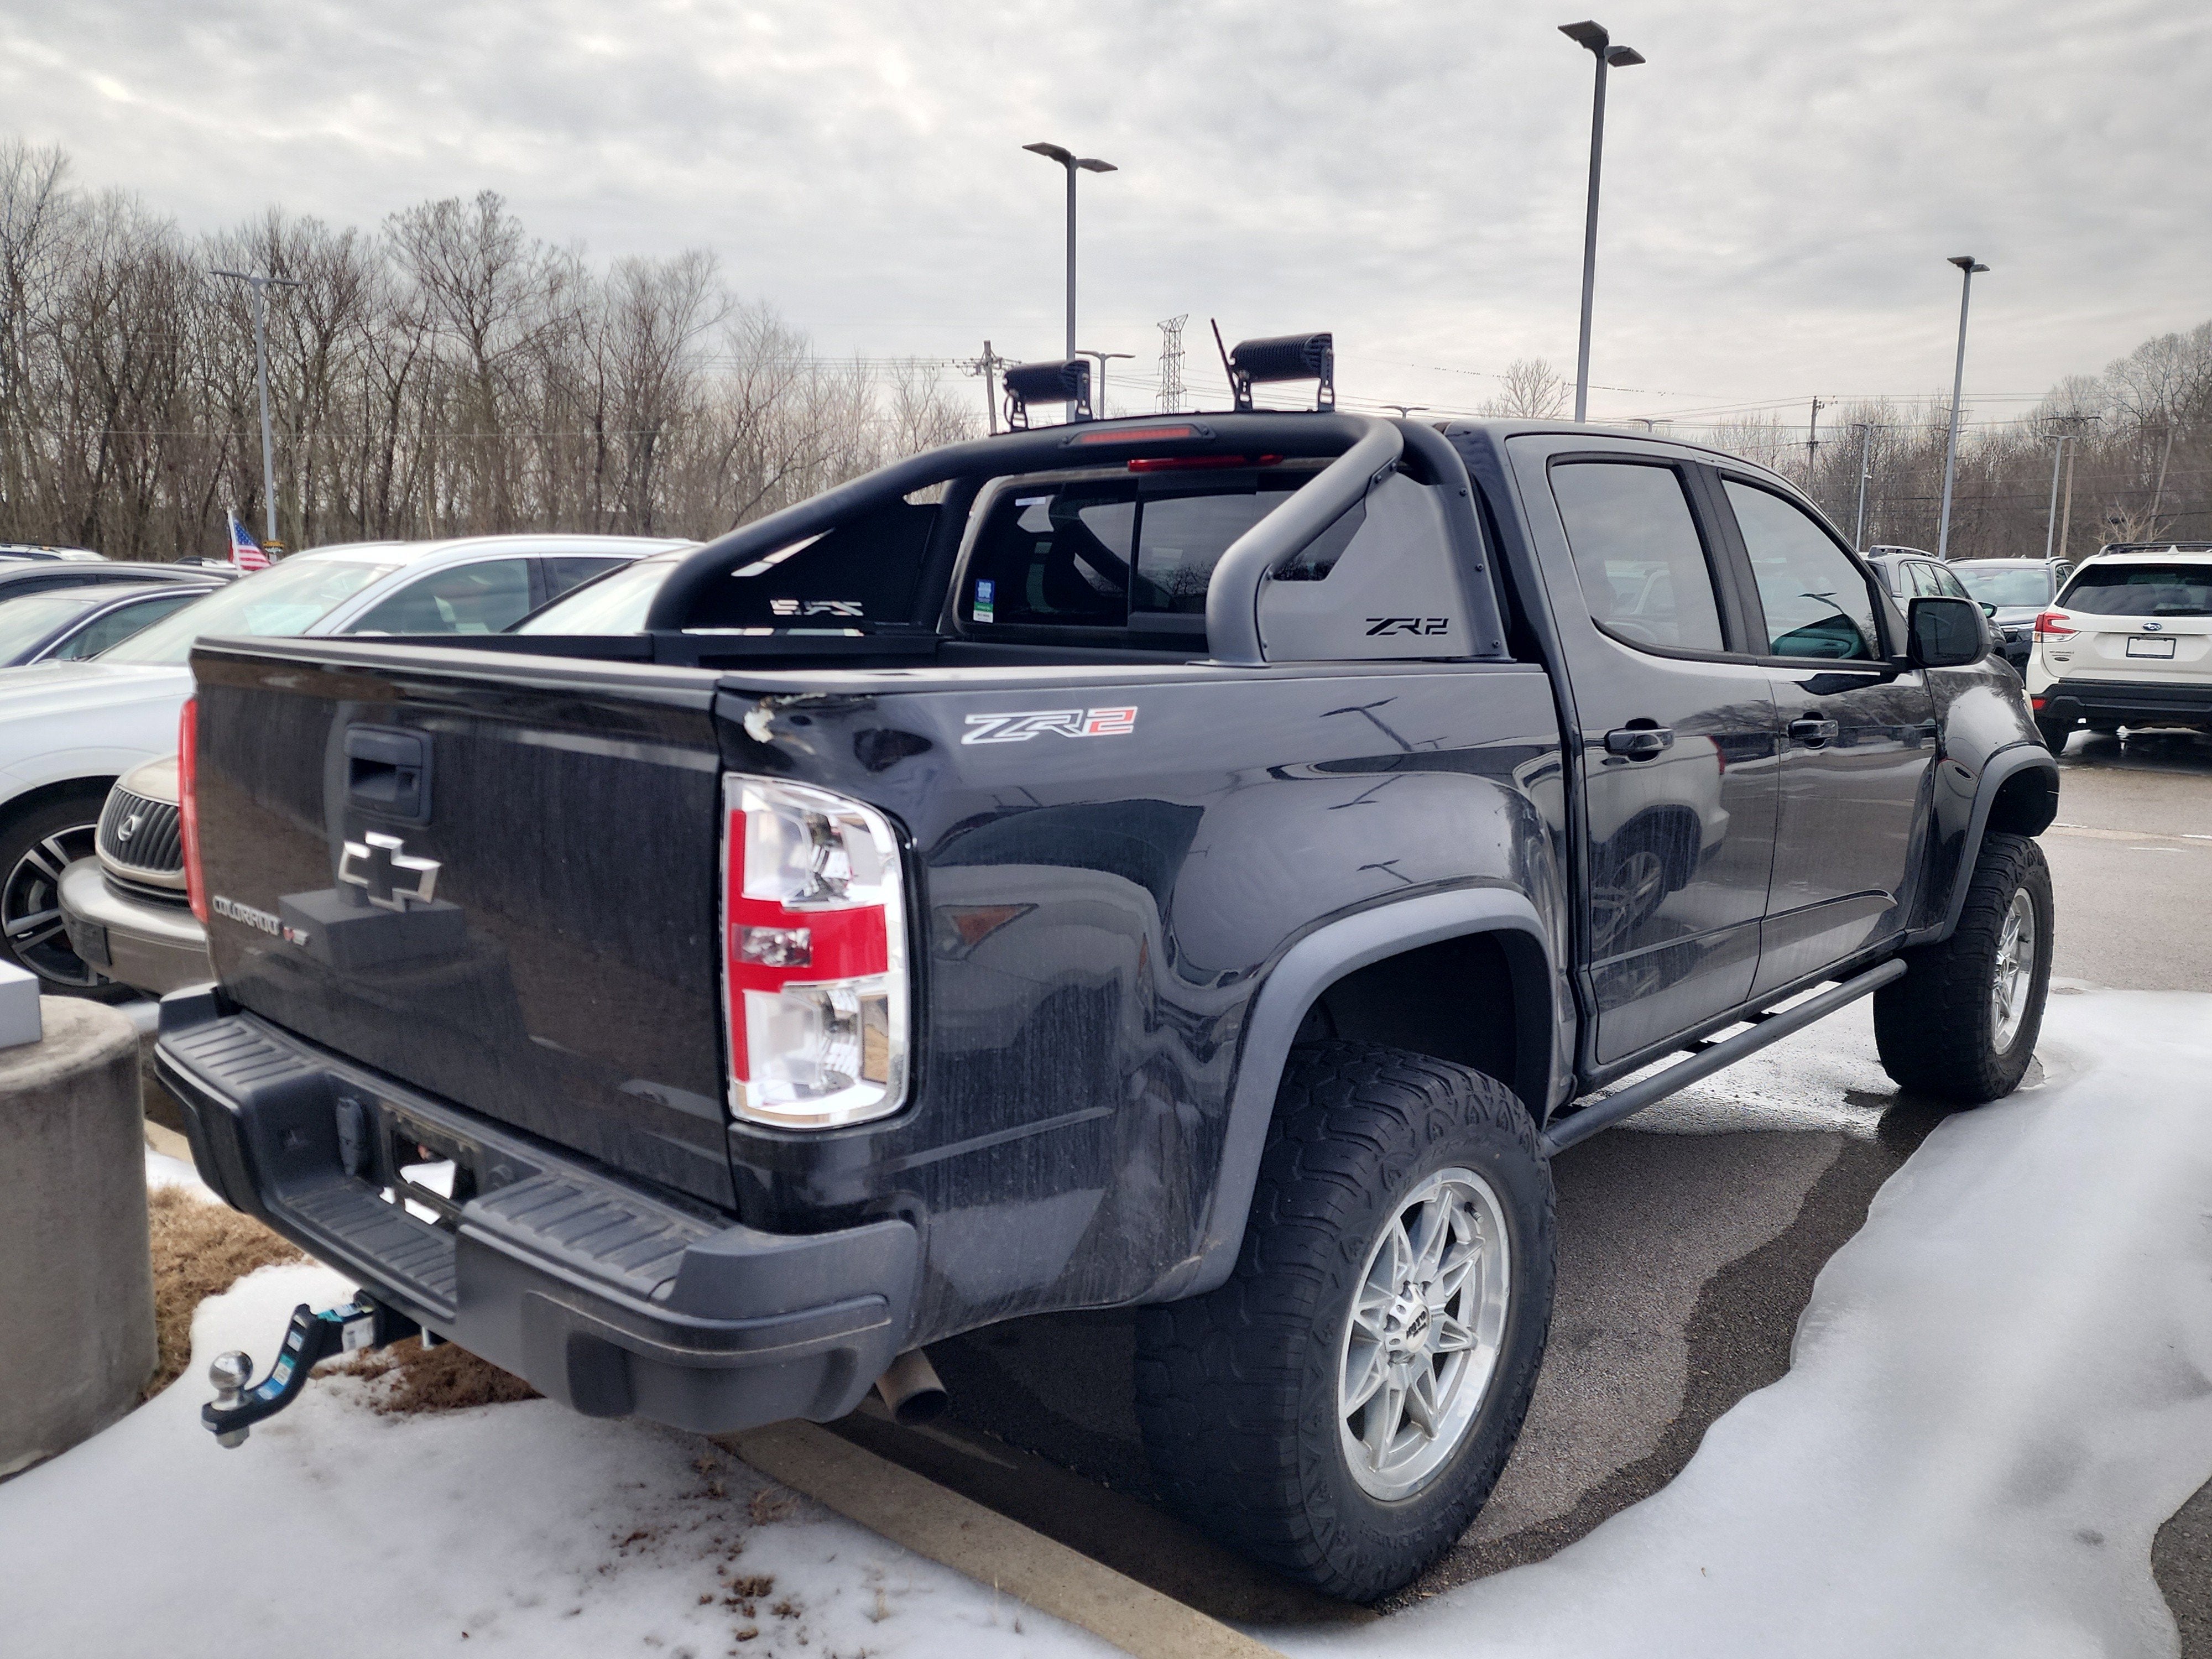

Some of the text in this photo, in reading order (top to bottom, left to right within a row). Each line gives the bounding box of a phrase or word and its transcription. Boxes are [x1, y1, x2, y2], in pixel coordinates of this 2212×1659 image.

[1366, 618, 1449, 635] ZR2
[961, 706, 1138, 744] ZR2
[212, 895, 280, 936] COLORADO
